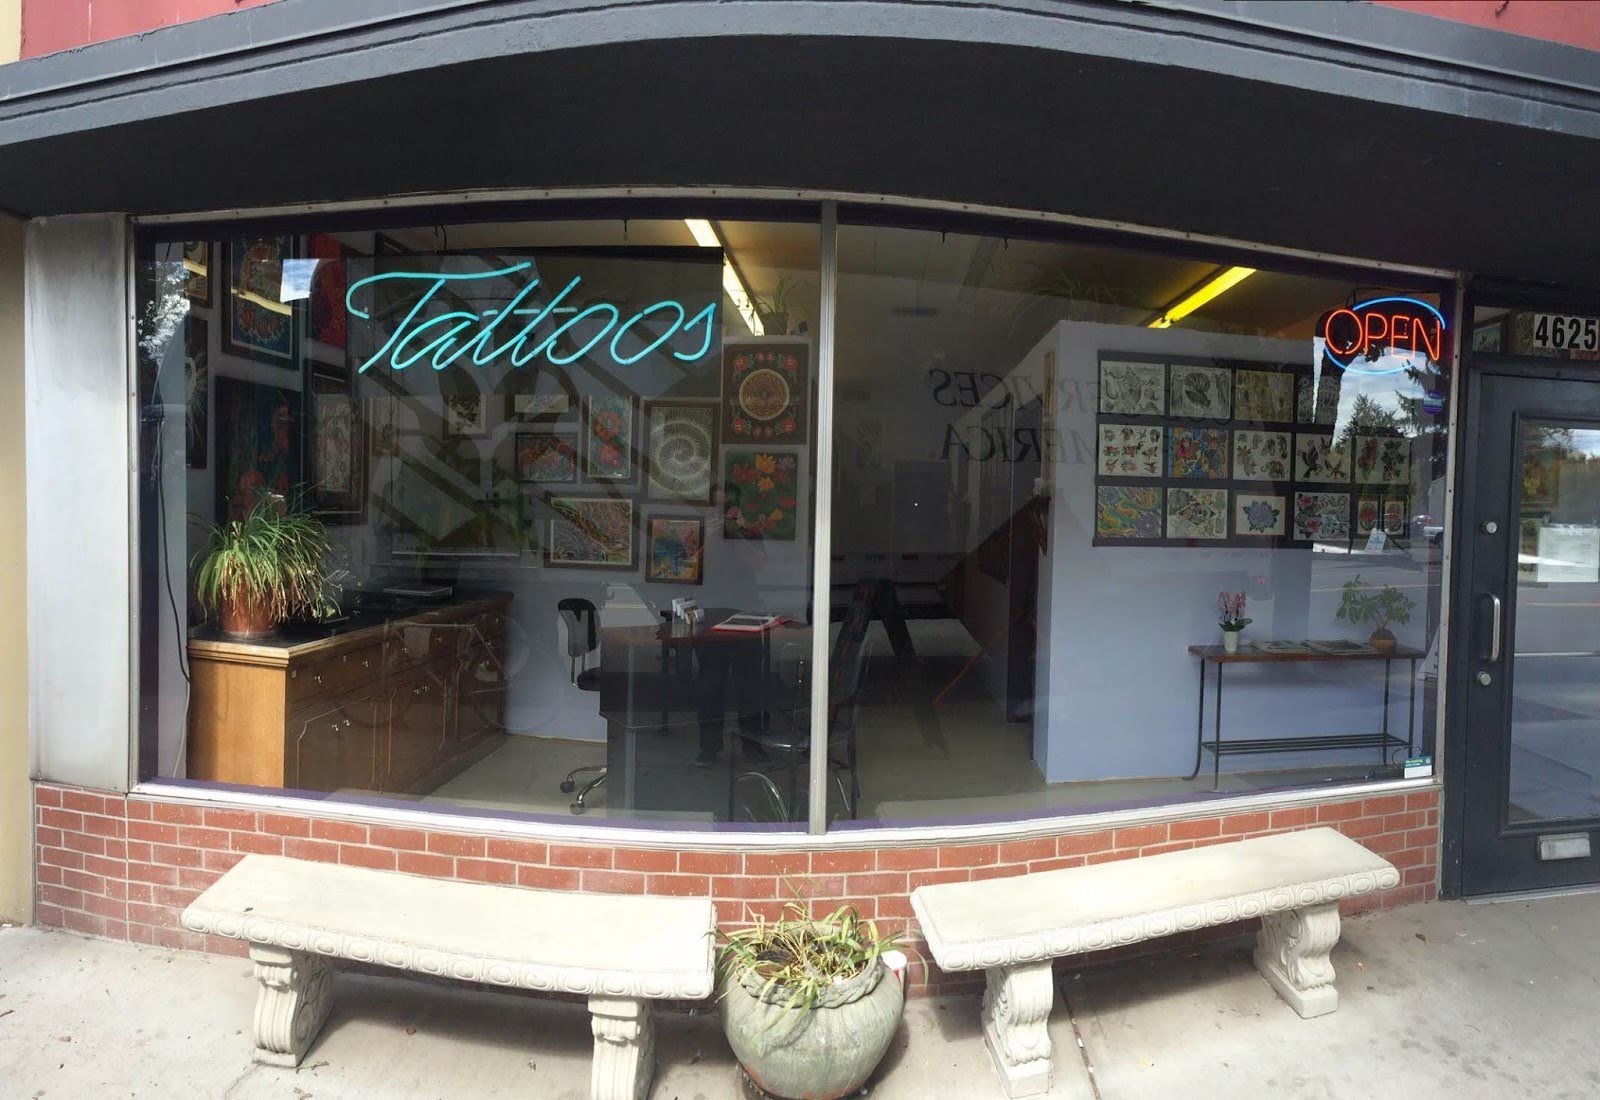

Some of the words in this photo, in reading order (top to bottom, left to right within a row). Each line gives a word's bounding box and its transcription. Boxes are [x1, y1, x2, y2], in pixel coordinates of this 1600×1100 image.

[346, 261, 716, 374] Tattoos
[1325, 308, 1441, 361] OPEN
[1535, 316, 1596, 350] 4625
